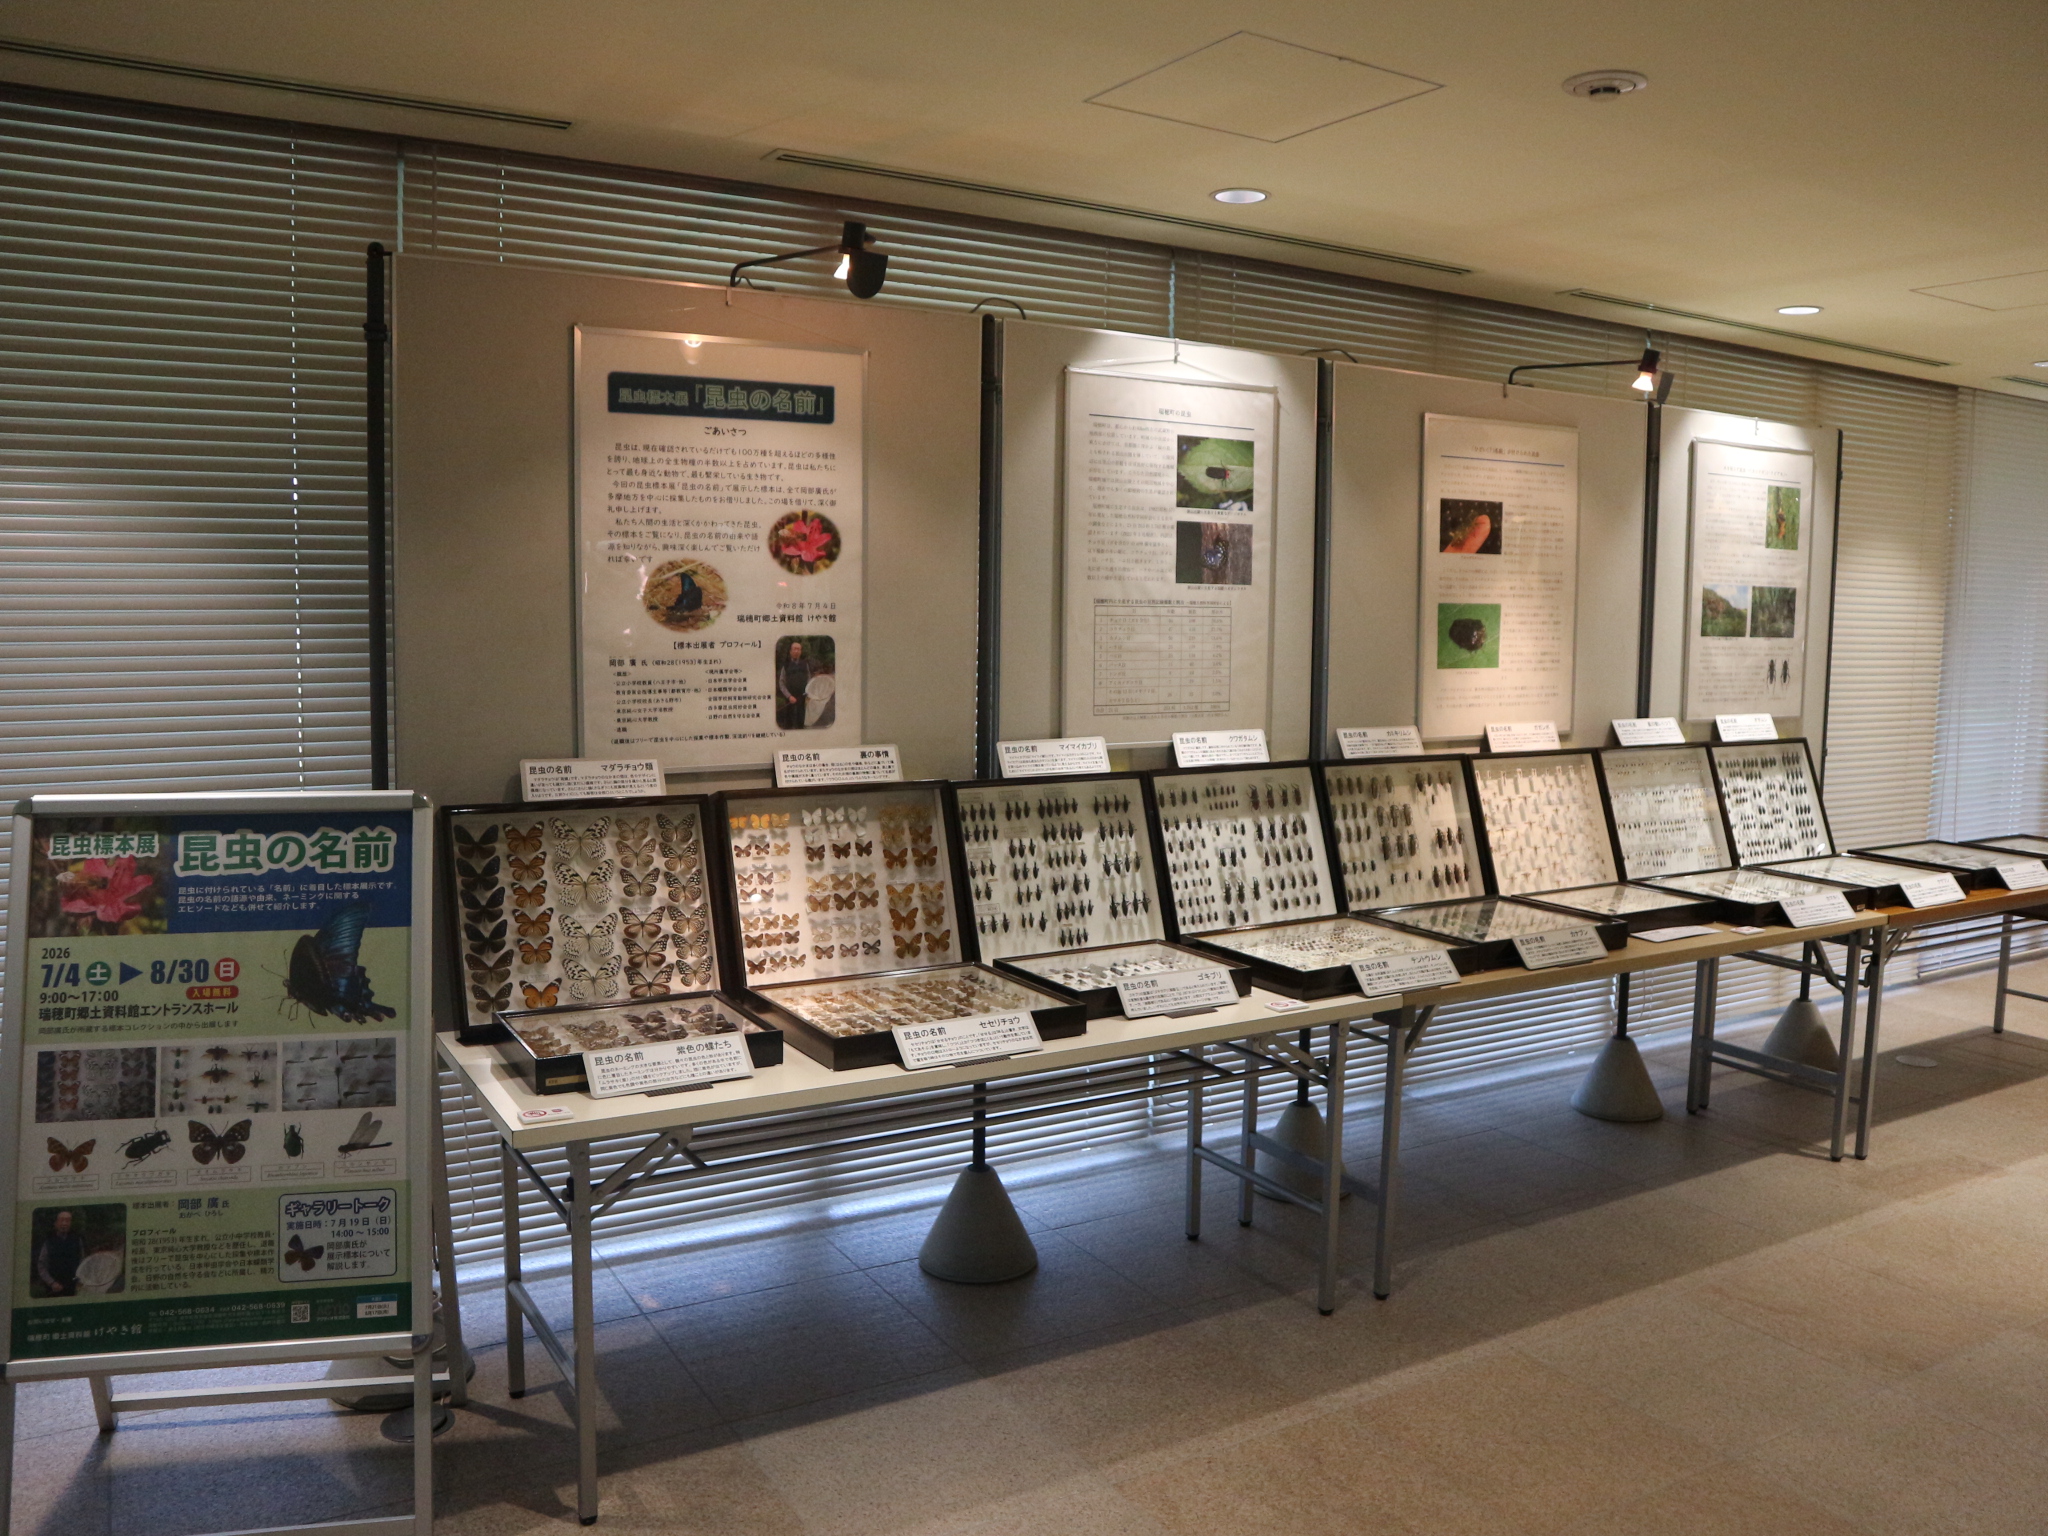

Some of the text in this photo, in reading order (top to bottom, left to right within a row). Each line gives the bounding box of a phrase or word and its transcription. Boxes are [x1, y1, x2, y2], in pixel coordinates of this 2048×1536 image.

[618, 387, 689, 408] 昆虫標本展
[704, 426, 747, 437] ごあいさつ
[736, 614, 837, 624] 瑞穂町郷土資料館 けやき館
[1179, 735, 1258, 745] 昆虫の名前 クワガタムシ
[1004, 742, 1098, 754] 昆虫の名前 マイマイカブリ
[782, 750, 889, 762] 昆虫の名前 裏の事情
[529, 761, 654, 775] 昆虫の名前 マダラチョウ類
[50, 833, 157, 858] 昆虫標本展
[179, 830, 393, 873] 昆虫の名前
[41, 947, 71, 960] 2026
[1358, 953, 1442, 972] 昆虫の名前 テントウムシ
[40, 963, 81, 988] 7/4
[89, 963, 108, 982] 土
[150, 958, 210, 984] 8/30
[1122, 971, 1222, 991] 昆虫の名前 ゴキブリ
[39, 990, 119, 1004] 9:00〜17:00
[192, 987, 232, 999] 入場無料
[38, 1001, 239, 1022] 瑞穂町郷土資料館エントランスホール
[902, 1015, 1021, 1041] 昆虫の名前 セセリチョウ
[594, 1039, 732, 1066] 昆虫の名前 紫色の蝶たち
[178, 1198, 202, 1211] 岡部
[207, 1197, 219, 1209] 廣
[222, 1200, 230, 1209] 氏
[285, 1196, 392, 1218] ギャラリートーク
[204, 1209, 224, 1217] ひろし
[131, 1227, 177, 1237] プロフィール
[331, 1229, 354, 1238] 14:00
[367, 1227, 390, 1236] 15:00
[326, 1240, 368, 1251] 岡部廣氏が
[326, 1248, 391, 1261] 展示標本について
[94, 1323, 143, 1336] けやき館
